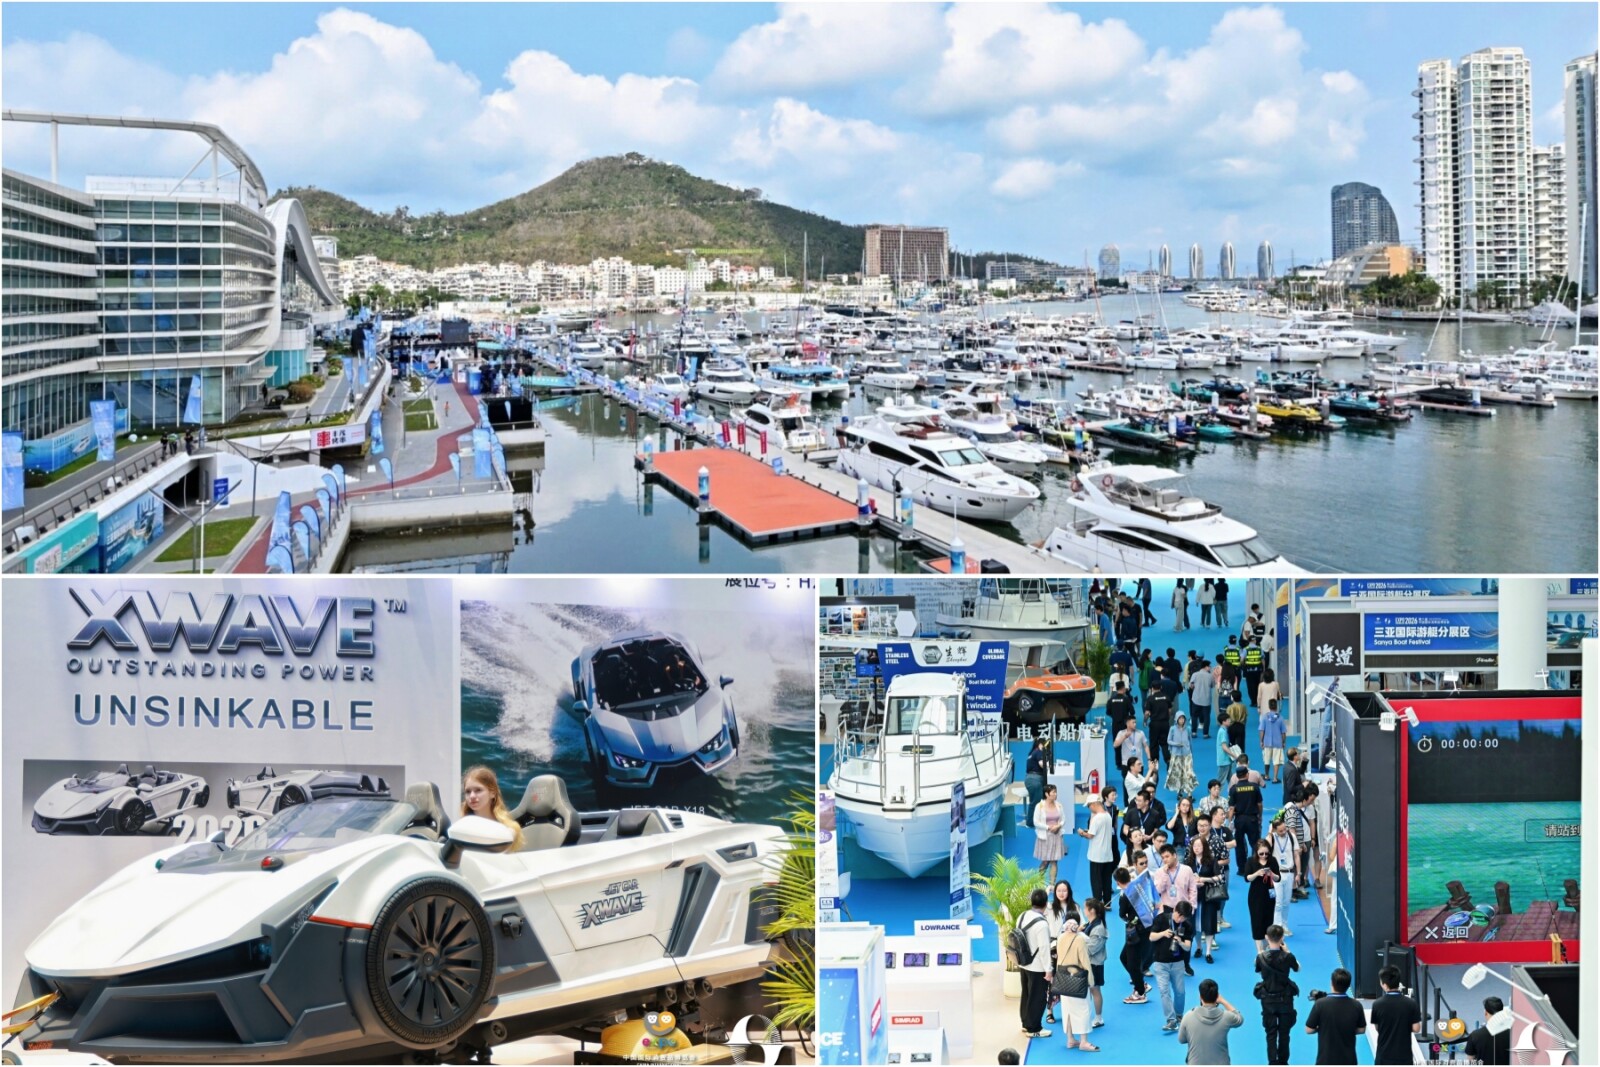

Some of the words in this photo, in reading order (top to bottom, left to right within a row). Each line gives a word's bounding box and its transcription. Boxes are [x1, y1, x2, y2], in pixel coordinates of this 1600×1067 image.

[67, 587, 375, 658] XWAVE
[1374, 626, 1470, 638] 三亚国际游艇分展区
[67, 658, 266, 679] OUTSTANDING
[281, 662, 375, 681] POWER
[73, 693, 374, 731] UNSINKABLE
[1441, 738, 1499, 749] 00:00:00
[581, 891, 643, 929] XWAVE
[1442, 926, 1469, 938] 返回
